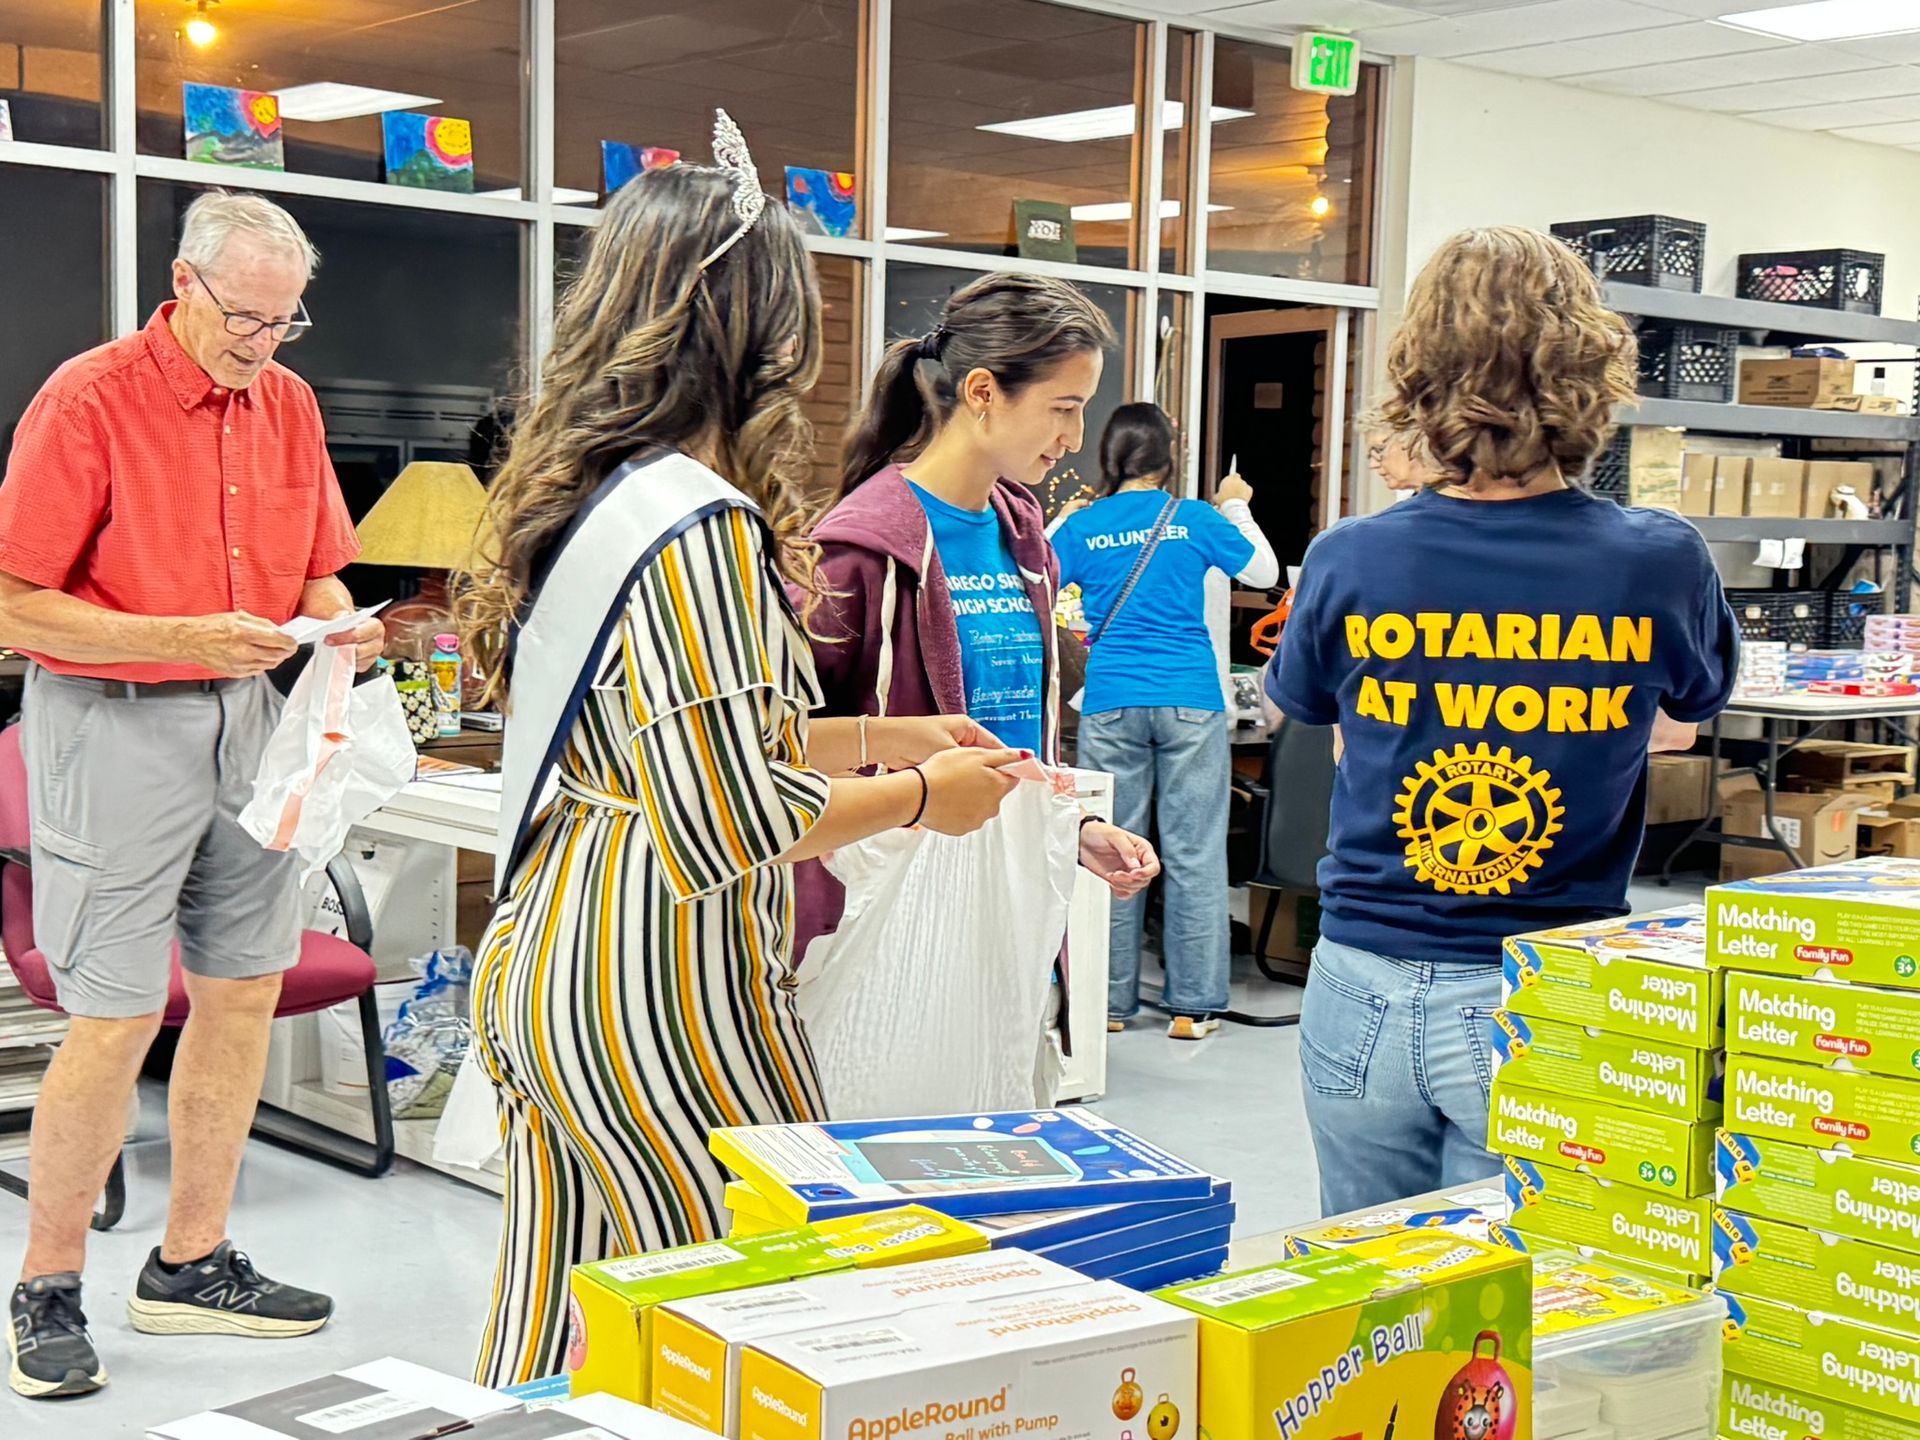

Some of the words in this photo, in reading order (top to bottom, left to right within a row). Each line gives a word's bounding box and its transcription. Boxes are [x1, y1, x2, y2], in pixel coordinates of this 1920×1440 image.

[1309, 36, 1355, 88] EXIT
[1344, 612, 1653, 663] ROTARIAN
[1356, 675, 1417, 726] AT
[1434, 683, 1634, 733] WORK
[1444, 760, 1520, 785] ROTARY
[1419, 839, 1530, 886] INTERNATIONAL
[1717, 903, 1816, 942] Matching
[1717, 931, 1779, 959] Letter
[1796, 946, 1830, 964] Family
[1830, 949, 1850, 963] Fun
[1641, 974, 1697, 1006] Letter
[1608, 988, 1697, 1033] Matching
[1738, 988, 1836, 1031] Matching
[1738, 1016, 1798, 1046] Letter
[1816, 1035, 1849, 1053] Family
[1849, 1039, 1868, 1054] Fun
[1631, 1048, 1686, 1079] Letter
[1599, 1061, 1686, 1107] Matching
[1736, 1069, 1834, 1114] Matching
[1498, 1094, 1578, 1139] Matching
[1736, 1096, 1796, 1128] Letter
[1813, 1119, 1847, 1137] Family
[1847, 1122, 1866, 1138] Fun
[1497, 1119, 1546, 1151] Letter
[1559, 1142, 1587, 1161] Family
[1586, 1147, 1603, 1162] Fun
[1870, 1176, 1920, 1206] etter
[1645, 1201, 1700, 1234] Letter
[1612, 1213, 1700, 1261] Matching
[1873, 1260, 1920, 1289] etter
[1274, 1346, 1363, 1440] Hopper
[1370, 1315, 1423, 1365] Ball
[1857, 1340, 1920, 1379] Letter
[1822, 1351, 1920, 1407] Matching
[848, 1386, 1007, 1440] AppleRound
[1729, 1407, 1788, 1440] Letter
[1730, 1380, 1825, 1435] Matching
[978, 1421, 1010, 1440] with
[1014, 1414, 1059, 1434] Pump
